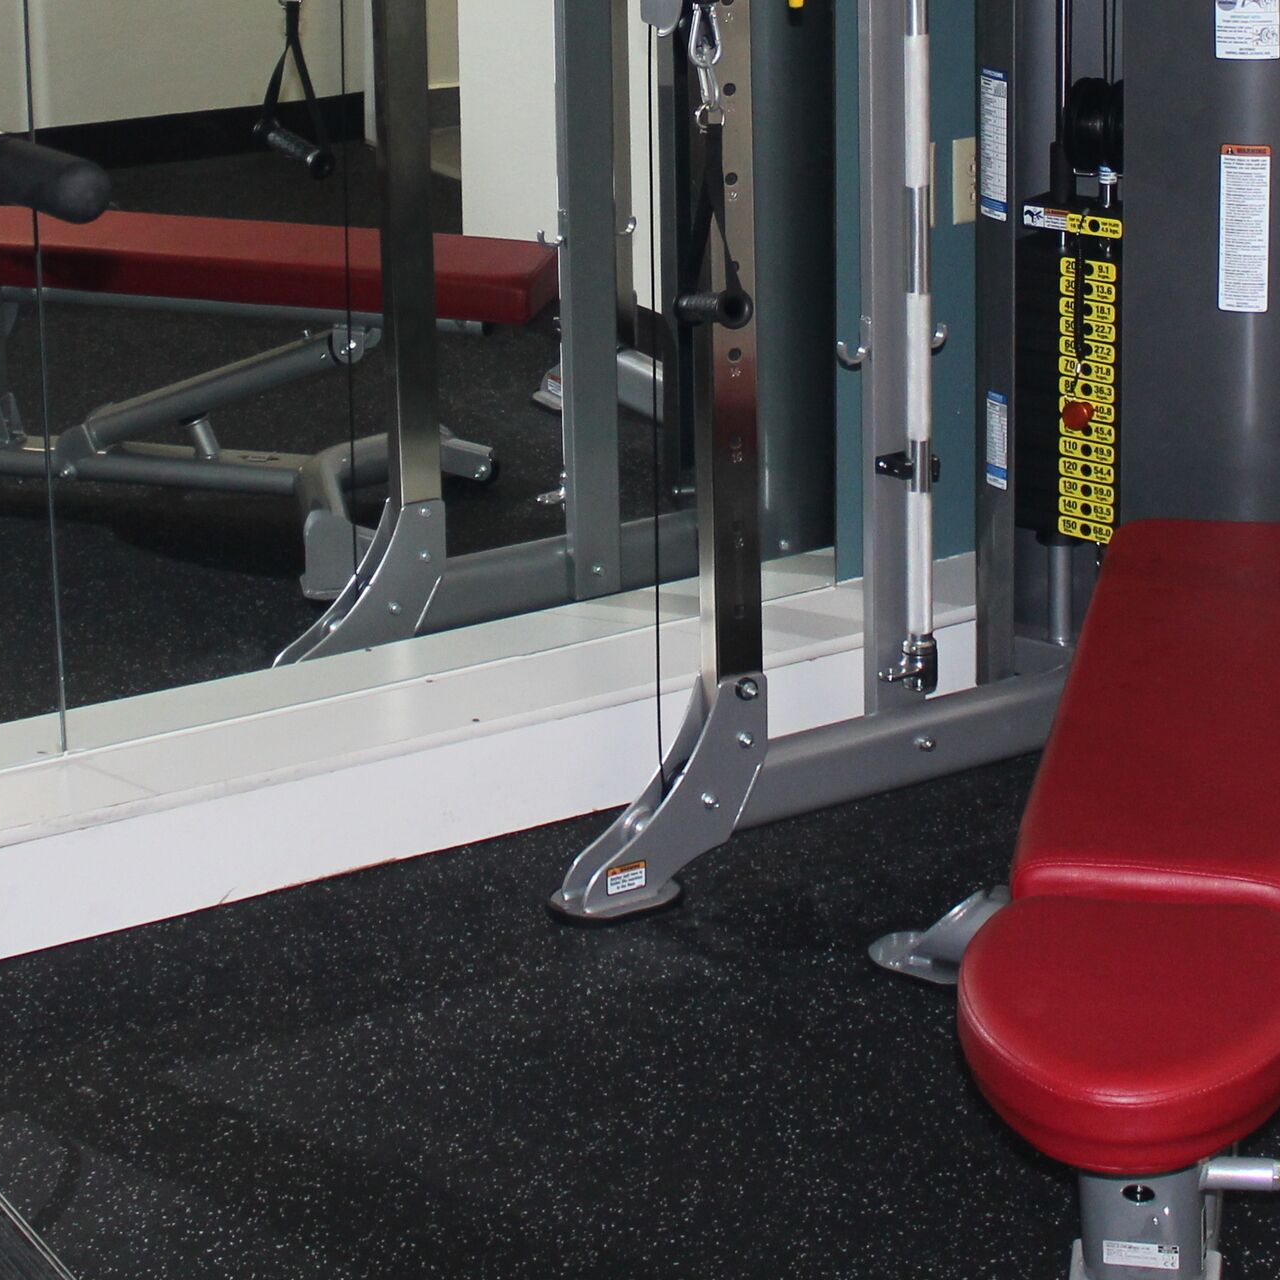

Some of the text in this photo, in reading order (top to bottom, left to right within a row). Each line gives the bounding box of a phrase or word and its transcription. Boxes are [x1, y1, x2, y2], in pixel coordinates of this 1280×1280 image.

[1097, 265, 1109, 274] 9.1
[1095, 285, 1113, 295] 13.6
[1095, 306, 1111, 315] 18.1
[1095, 324, 1112, 334] 22.7
[1094, 345, 1111, 356] 27.2
[1064, 359, 1075, 370] 70
[1094, 366, 1111, 376] 31.8
[1094, 386, 1112, 396] 36.3
[1094, 426, 1112, 437] 45.4
[1062, 440, 1078, 451] 110
[1094, 446, 1112, 457] 49.9
[1062, 460, 1078, 471] 120
[1093, 466, 1111, 477] 54.4
[1062, 480, 1078, 491] 130
[1094, 487, 1111, 497] 59.0
[1062, 499, 1078, 510] 140
[1093, 506, 1111, 516] 63.5
[1062, 519, 1077, 530] 150
[1092, 526, 1111, 537] 68.0
